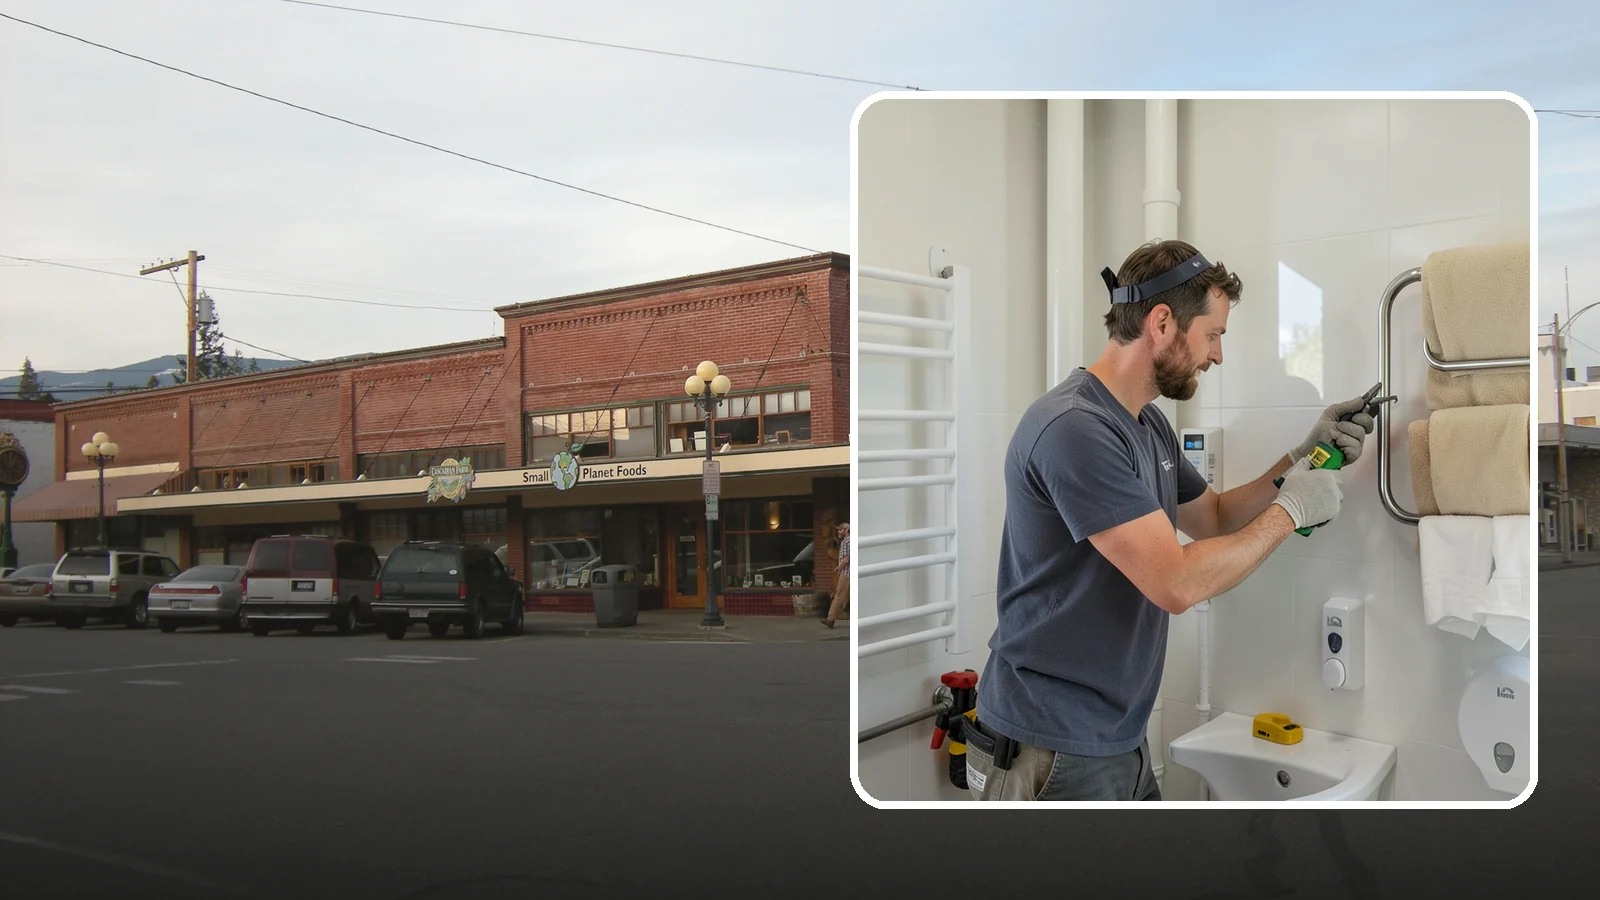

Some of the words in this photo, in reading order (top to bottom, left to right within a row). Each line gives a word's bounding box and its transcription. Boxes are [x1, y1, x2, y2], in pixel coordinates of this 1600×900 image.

[456, 466, 470, 475] FARM
[523, 471, 549, 483] Small
[583, 468, 614, 480] Planet
[617, 464, 647, 477] Foods
